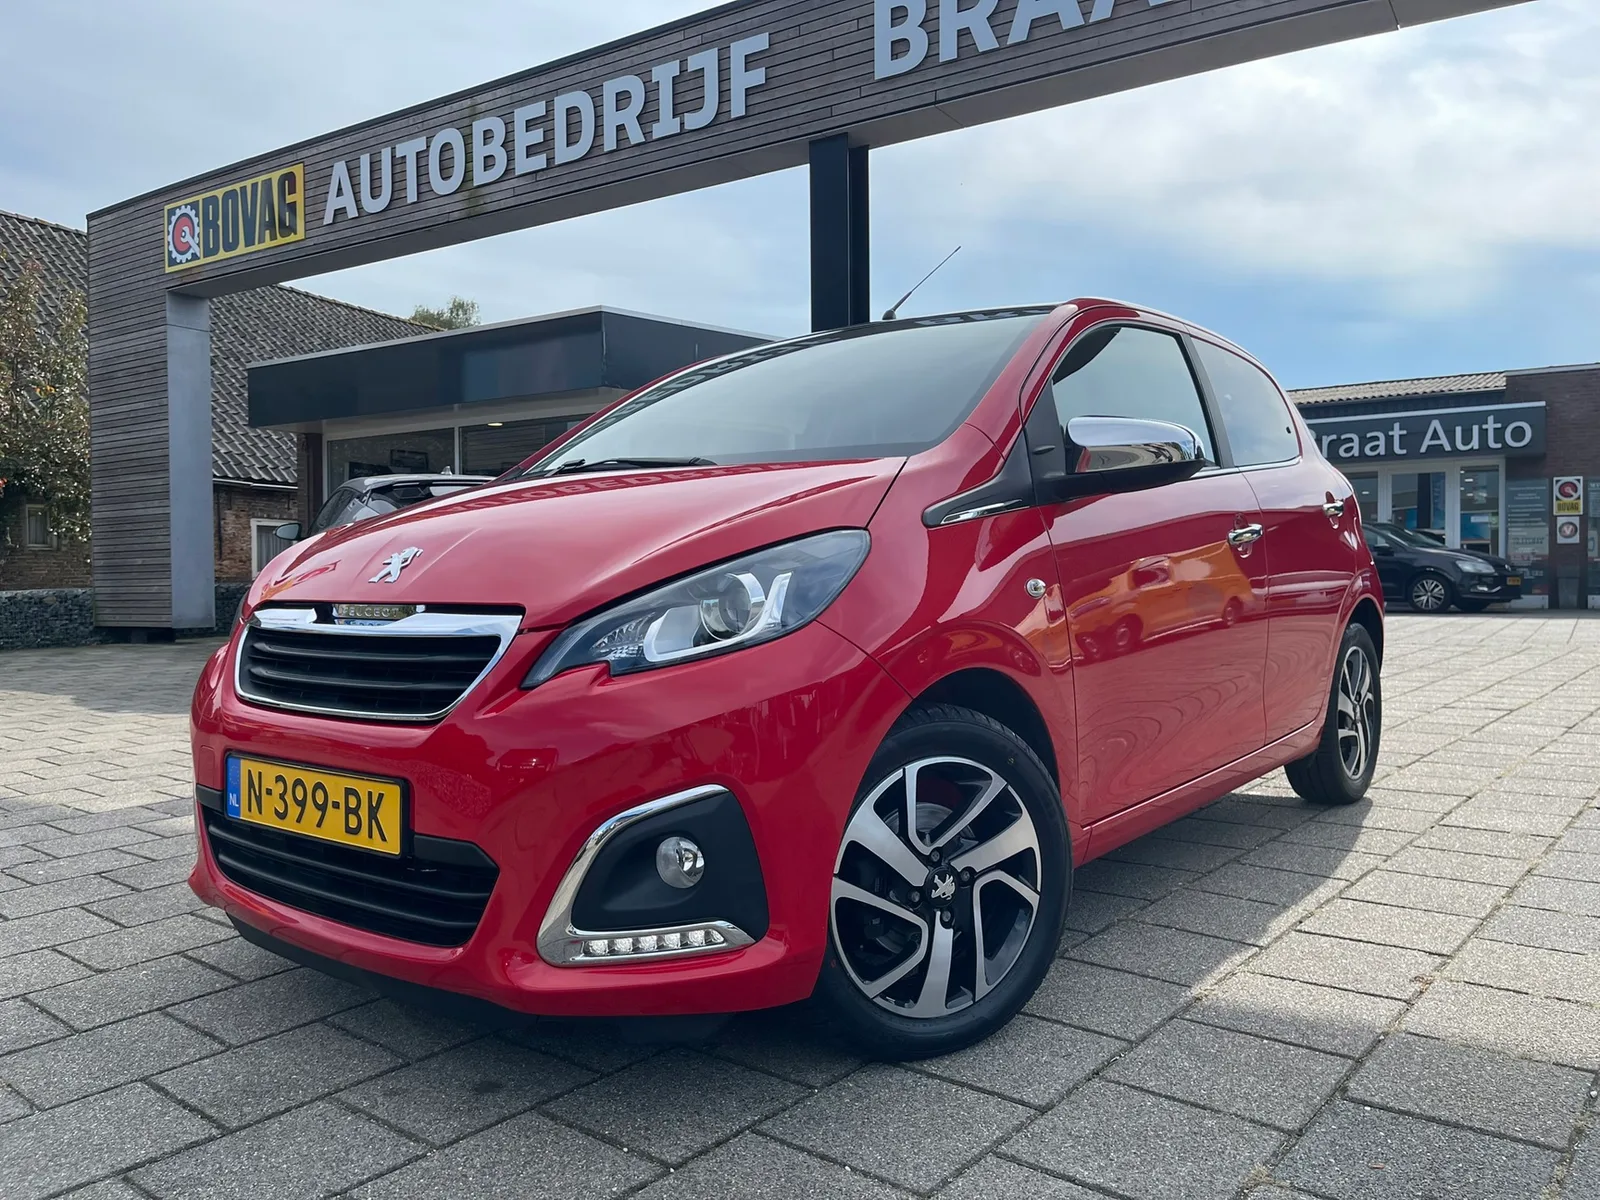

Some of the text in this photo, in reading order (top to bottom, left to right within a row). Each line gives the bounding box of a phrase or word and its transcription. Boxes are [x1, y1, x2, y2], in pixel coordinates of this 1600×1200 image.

[322, 0, 1167, 225] AUTOBEDRIJF BR
[202, 171, 298, 259] BOVAG
[1419, 414, 1533, 453] Auto
[229, 769, 388, 842] NL N-399-BK
